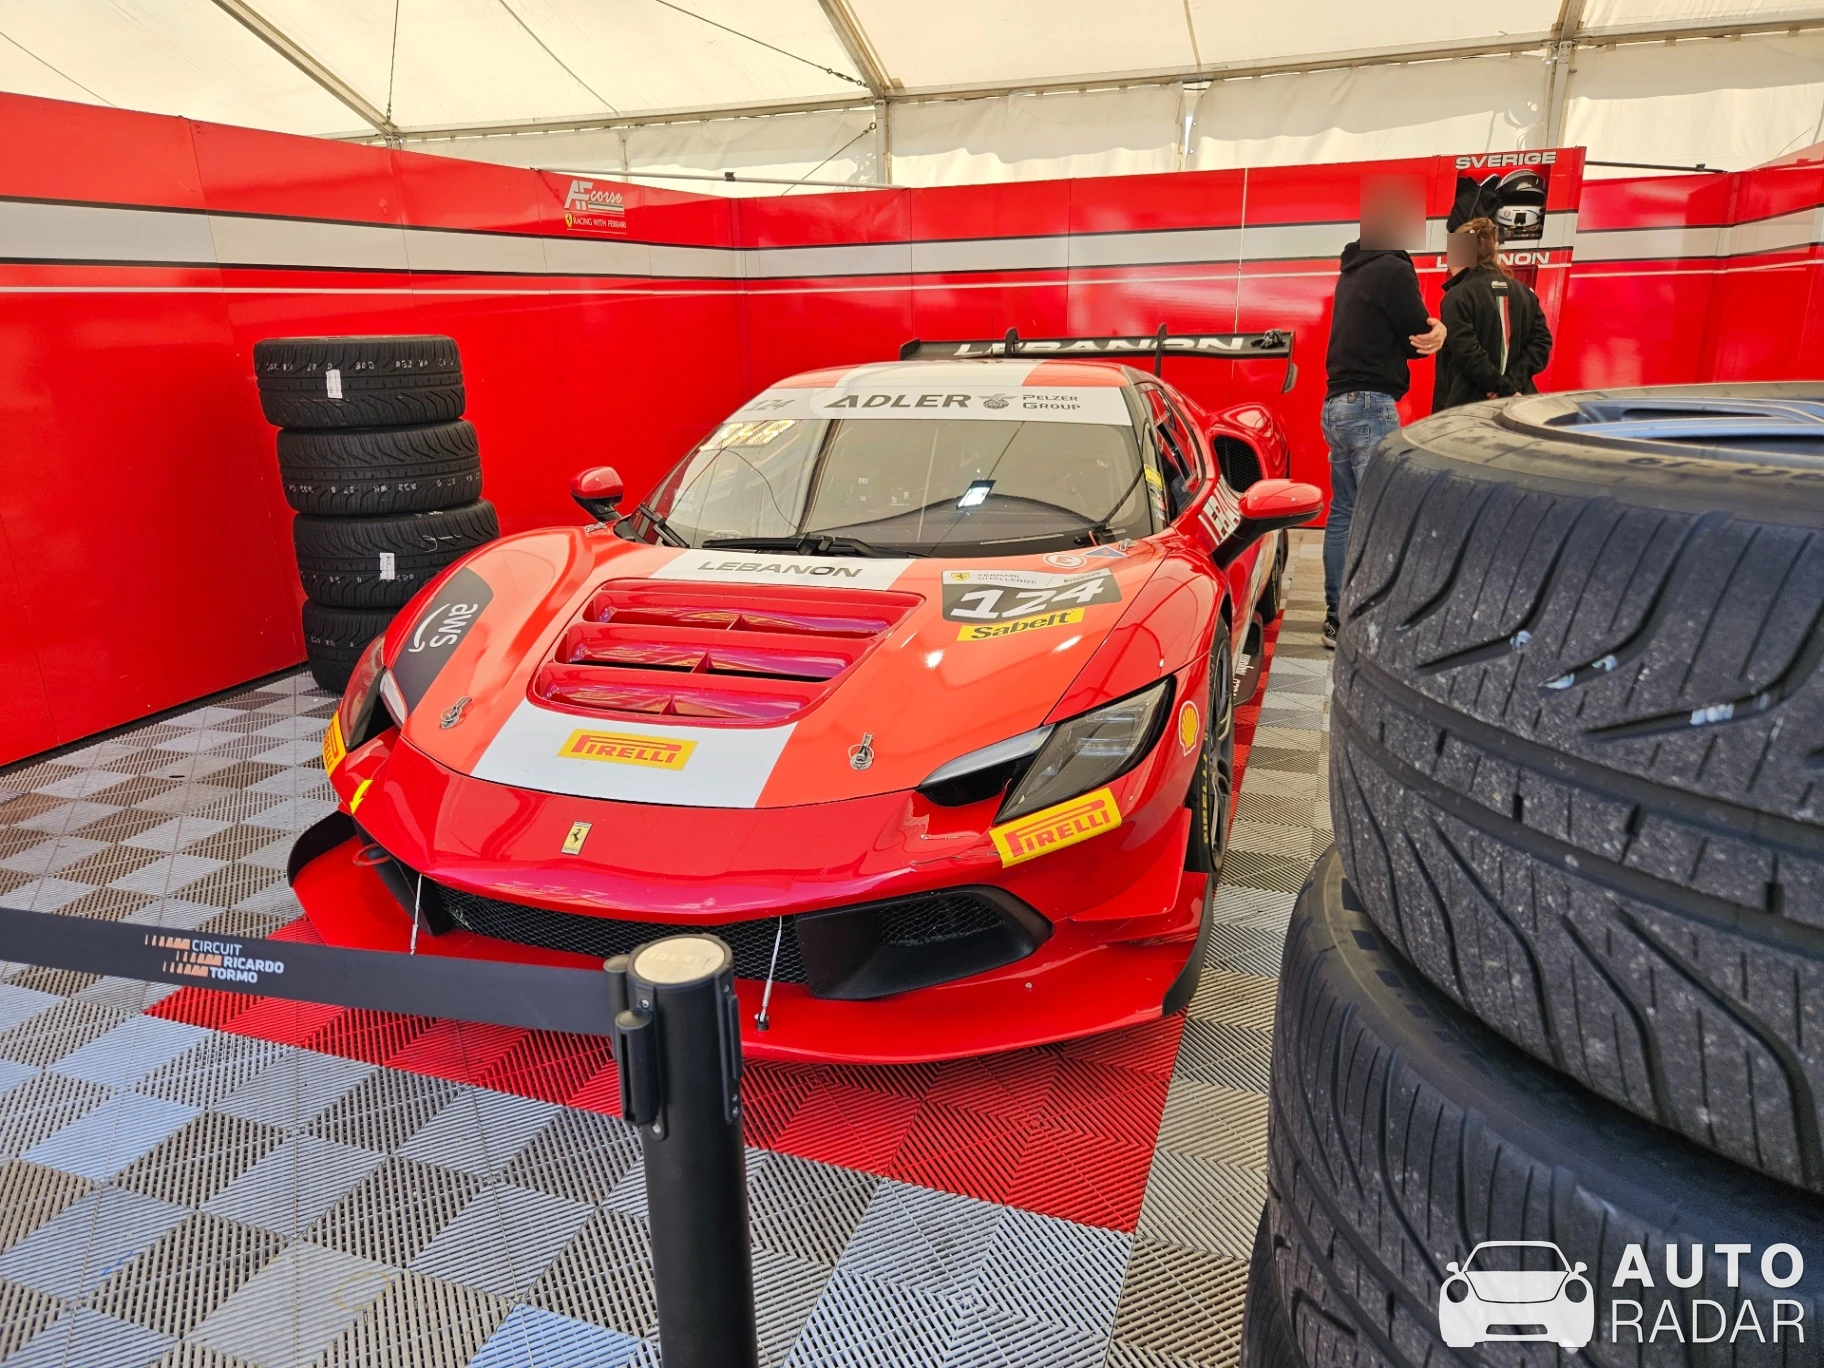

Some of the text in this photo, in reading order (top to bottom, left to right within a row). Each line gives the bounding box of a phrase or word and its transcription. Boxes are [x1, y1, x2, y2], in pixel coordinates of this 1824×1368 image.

[1455, 151, 1557, 170] SVERIGE
[590, 190, 622, 203] corse
[573, 216, 627, 229] RACING WITH FERRARI
[823, 394, 971, 409] ADLER
[1022, 394, 1079, 403] PELZER
[1022, 402, 1081, 411] GROUP
[697, 561, 863, 579] LEBANON
[950, 577, 1106, 619] 124
[429, 603, 479, 648] aws
[971, 611, 1072, 640] Sabelt
[571, 734, 683, 764] PIRELLI
[1004, 799, 1111, 858] PIRELLI
[192, 939, 242, 955] CIRCUIT
[223, 956, 284, 974] RICARDO
[210, 967, 258, 983] TORMO
